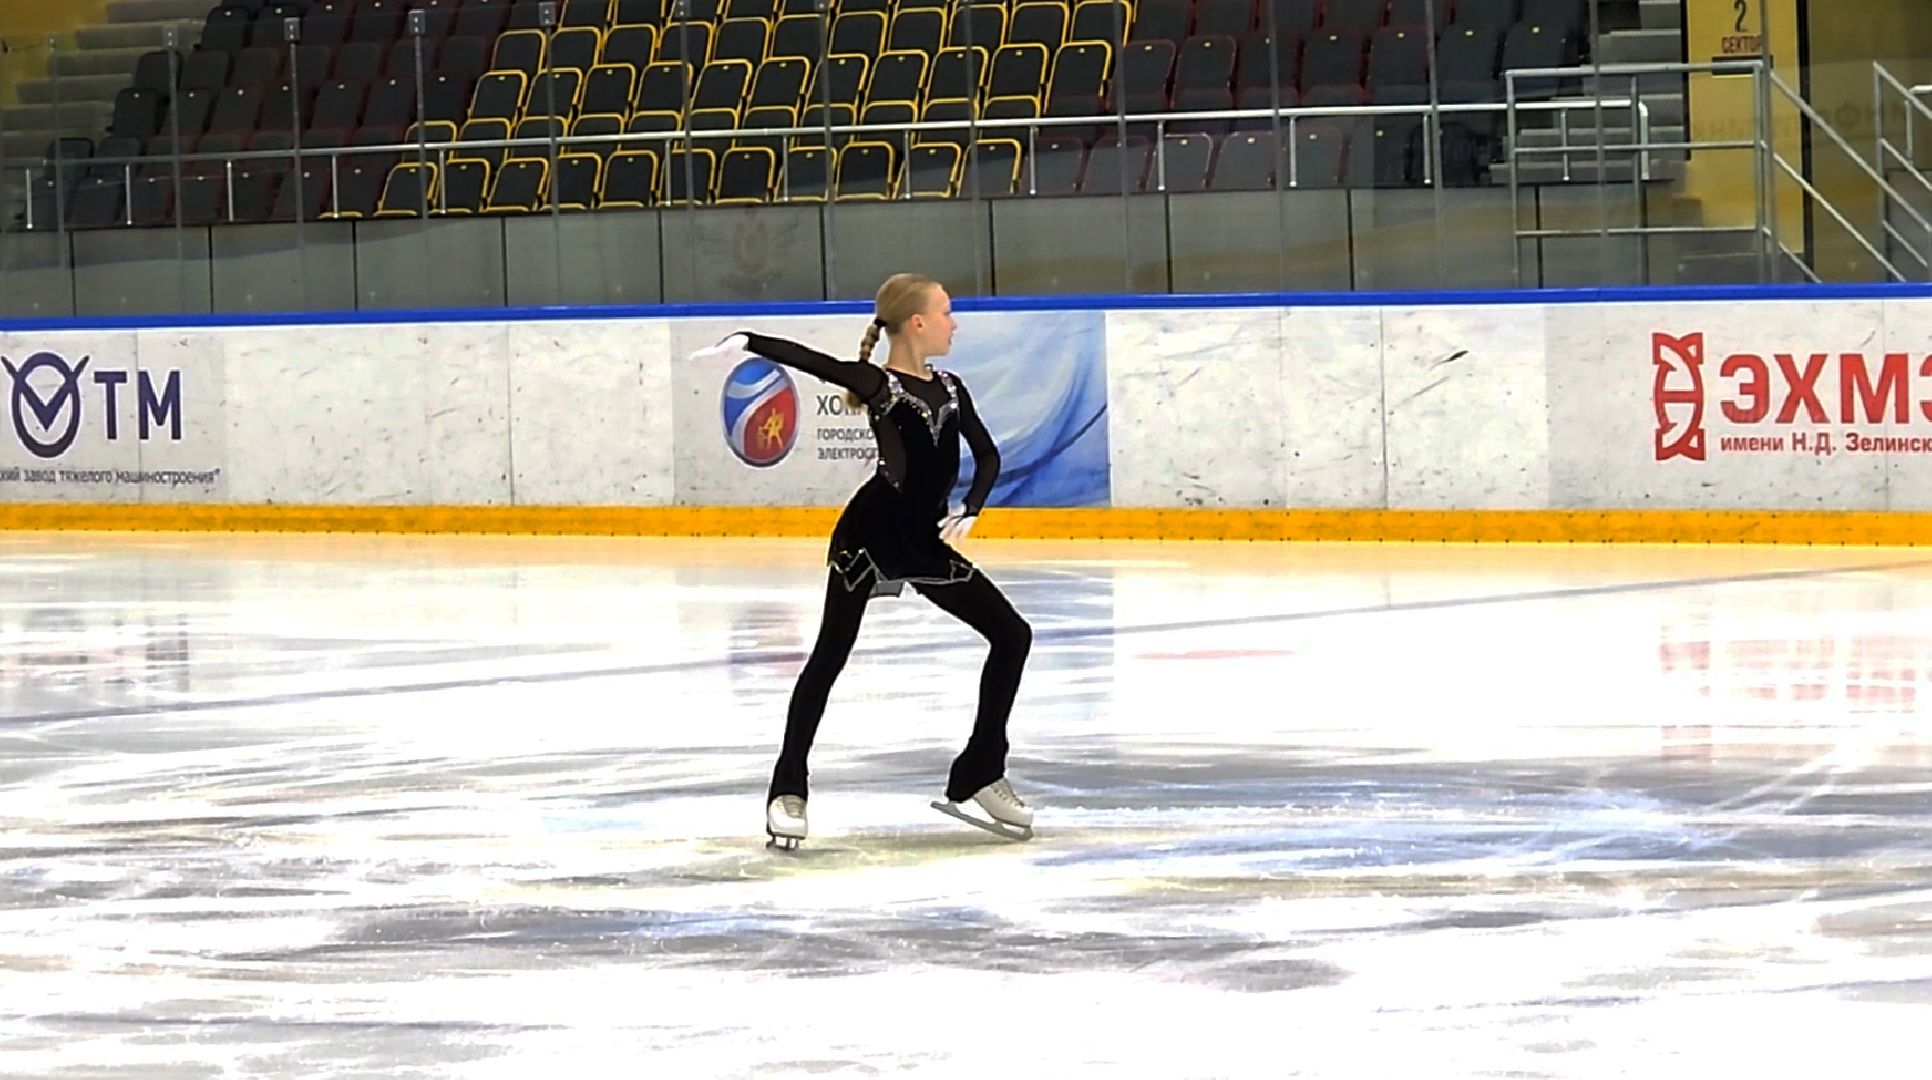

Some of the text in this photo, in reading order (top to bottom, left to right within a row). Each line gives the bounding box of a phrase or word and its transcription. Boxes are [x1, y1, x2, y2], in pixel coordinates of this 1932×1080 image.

[1733, 0, 1748, 32] 2
[1720, 353, 1932, 424] ЭХМ
[816, 427, 876, 442] ГОРОДСКО
[1720, 437, 1783, 451] имени
[1792, 432, 1837, 456] Н.Д.
[817, 447, 878, 460] ЭЛЕКТРОСТ
[0, 467, 20, 483] кий
[24, 469, 56, 484] завод
[59, 470, 111, 484] тяжелого
